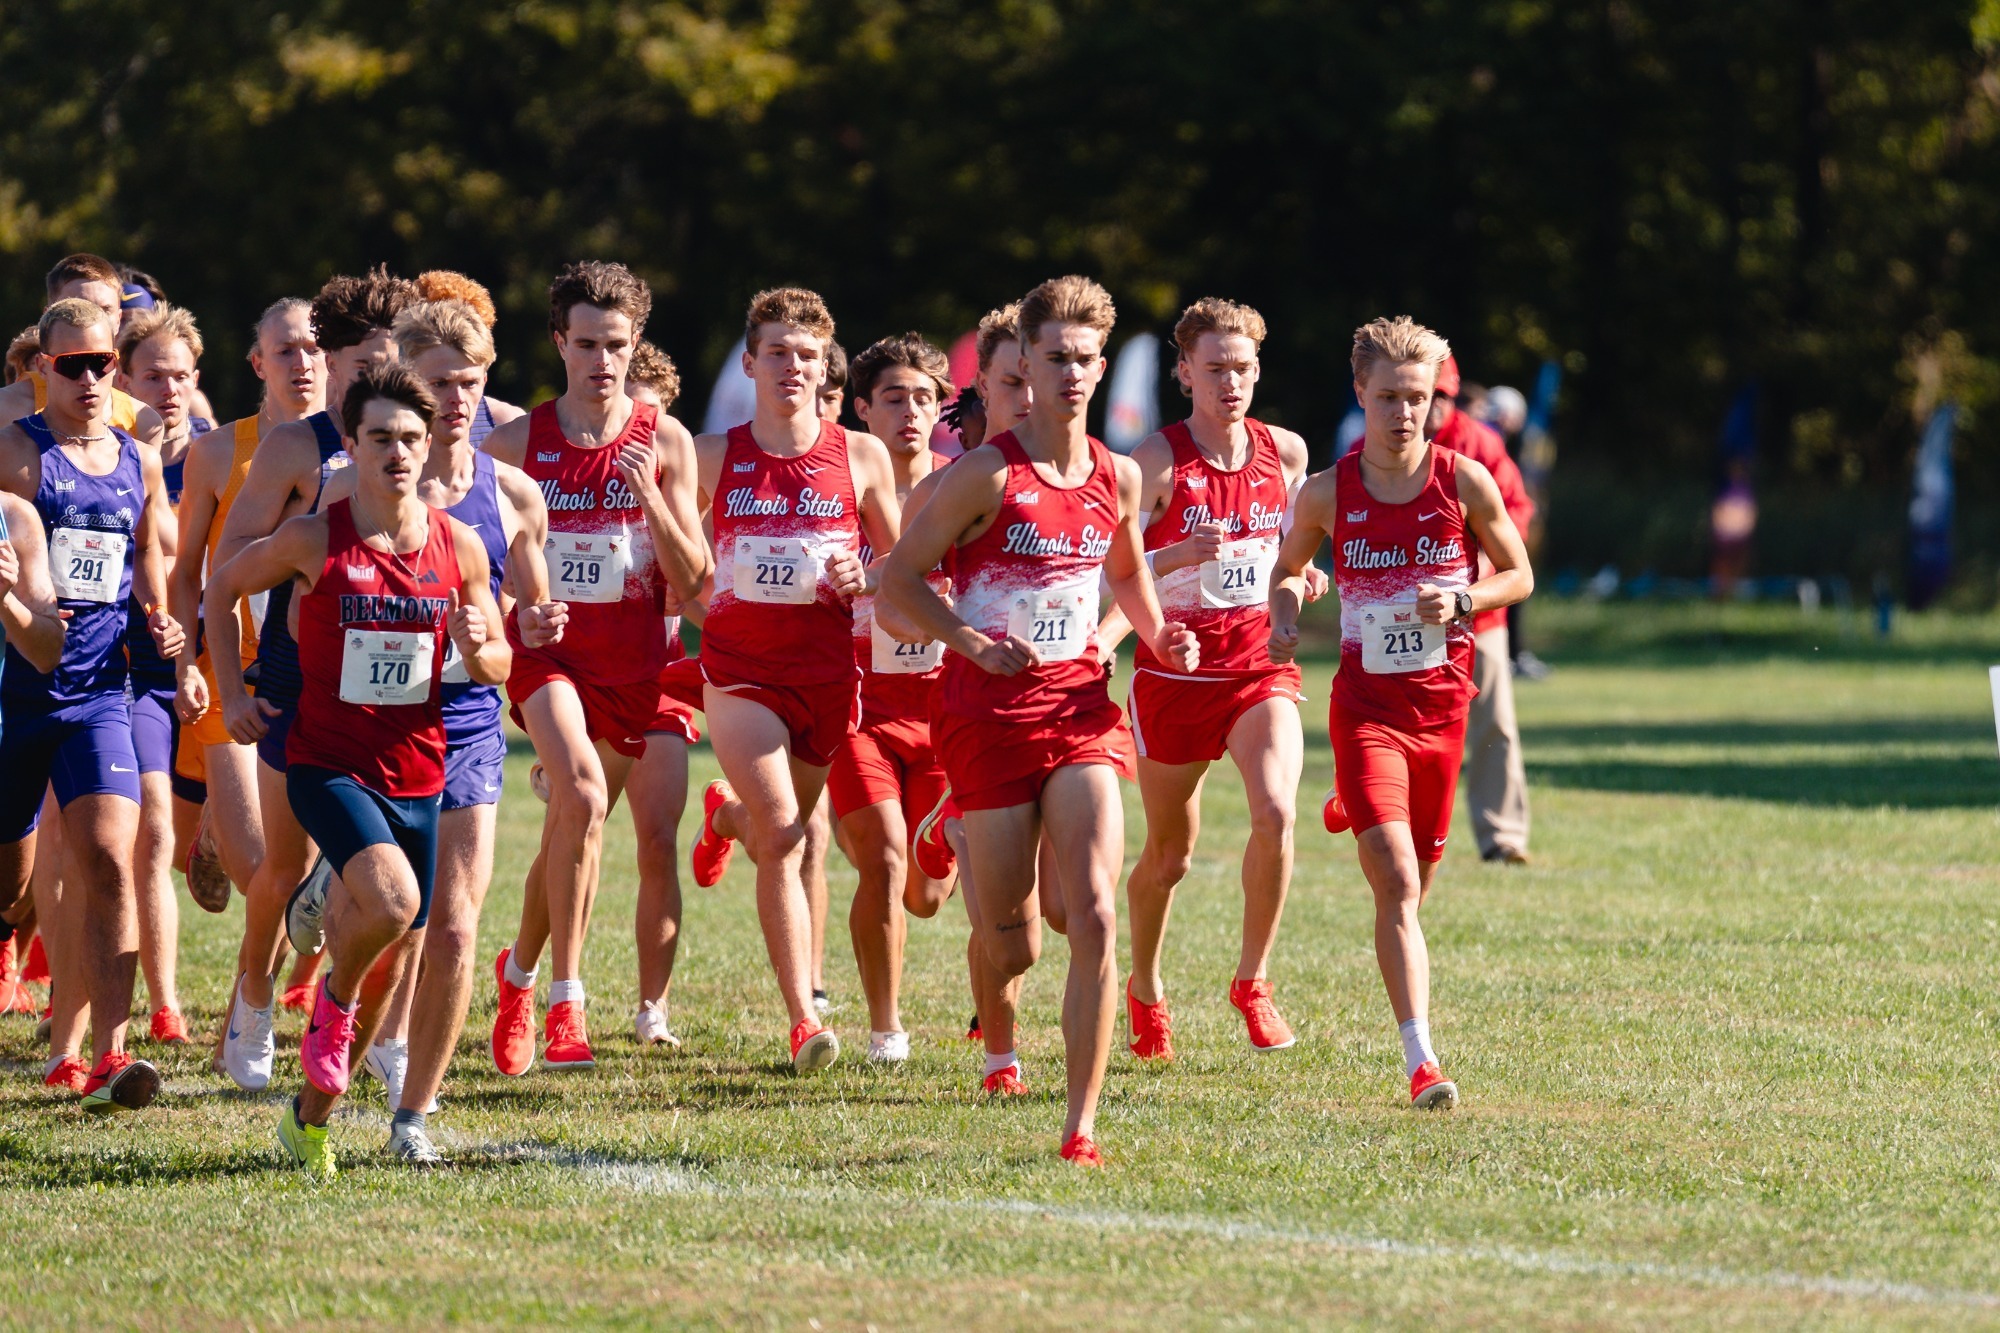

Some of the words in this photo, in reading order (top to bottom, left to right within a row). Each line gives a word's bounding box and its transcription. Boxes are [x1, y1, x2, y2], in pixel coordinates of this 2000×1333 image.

[537, 451, 561, 462] VALLEY
[733, 462, 756, 473] VALLEY
[537, 479, 597, 511] llinois
[602, 478, 640, 510] Sta
[724, 487, 790, 518] Illinois
[795, 487, 844, 519] State
[59, 504, 134, 530] Evansville
[1248, 501, 1283, 532] State
[1001, 522, 1074, 557] Illinois
[1079, 524, 1114, 557] Stat
[1342, 538, 1409, 569] Illinois
[1415, 536, 1461, 566] State
[68, 557, 104, 582] 291
[346, 564, 376, 579] VALLEY
[560, 560, 600, 584] 219
[756, 563, 794, 586] 212
[1222, 565, 1256, 590] 214
[339, 594, 449, 627] BELMONT
[1033, 618, 1067, 643] 211
[1384, 631, 1423, 655] 213
[369, 661, 410, 685] 170
